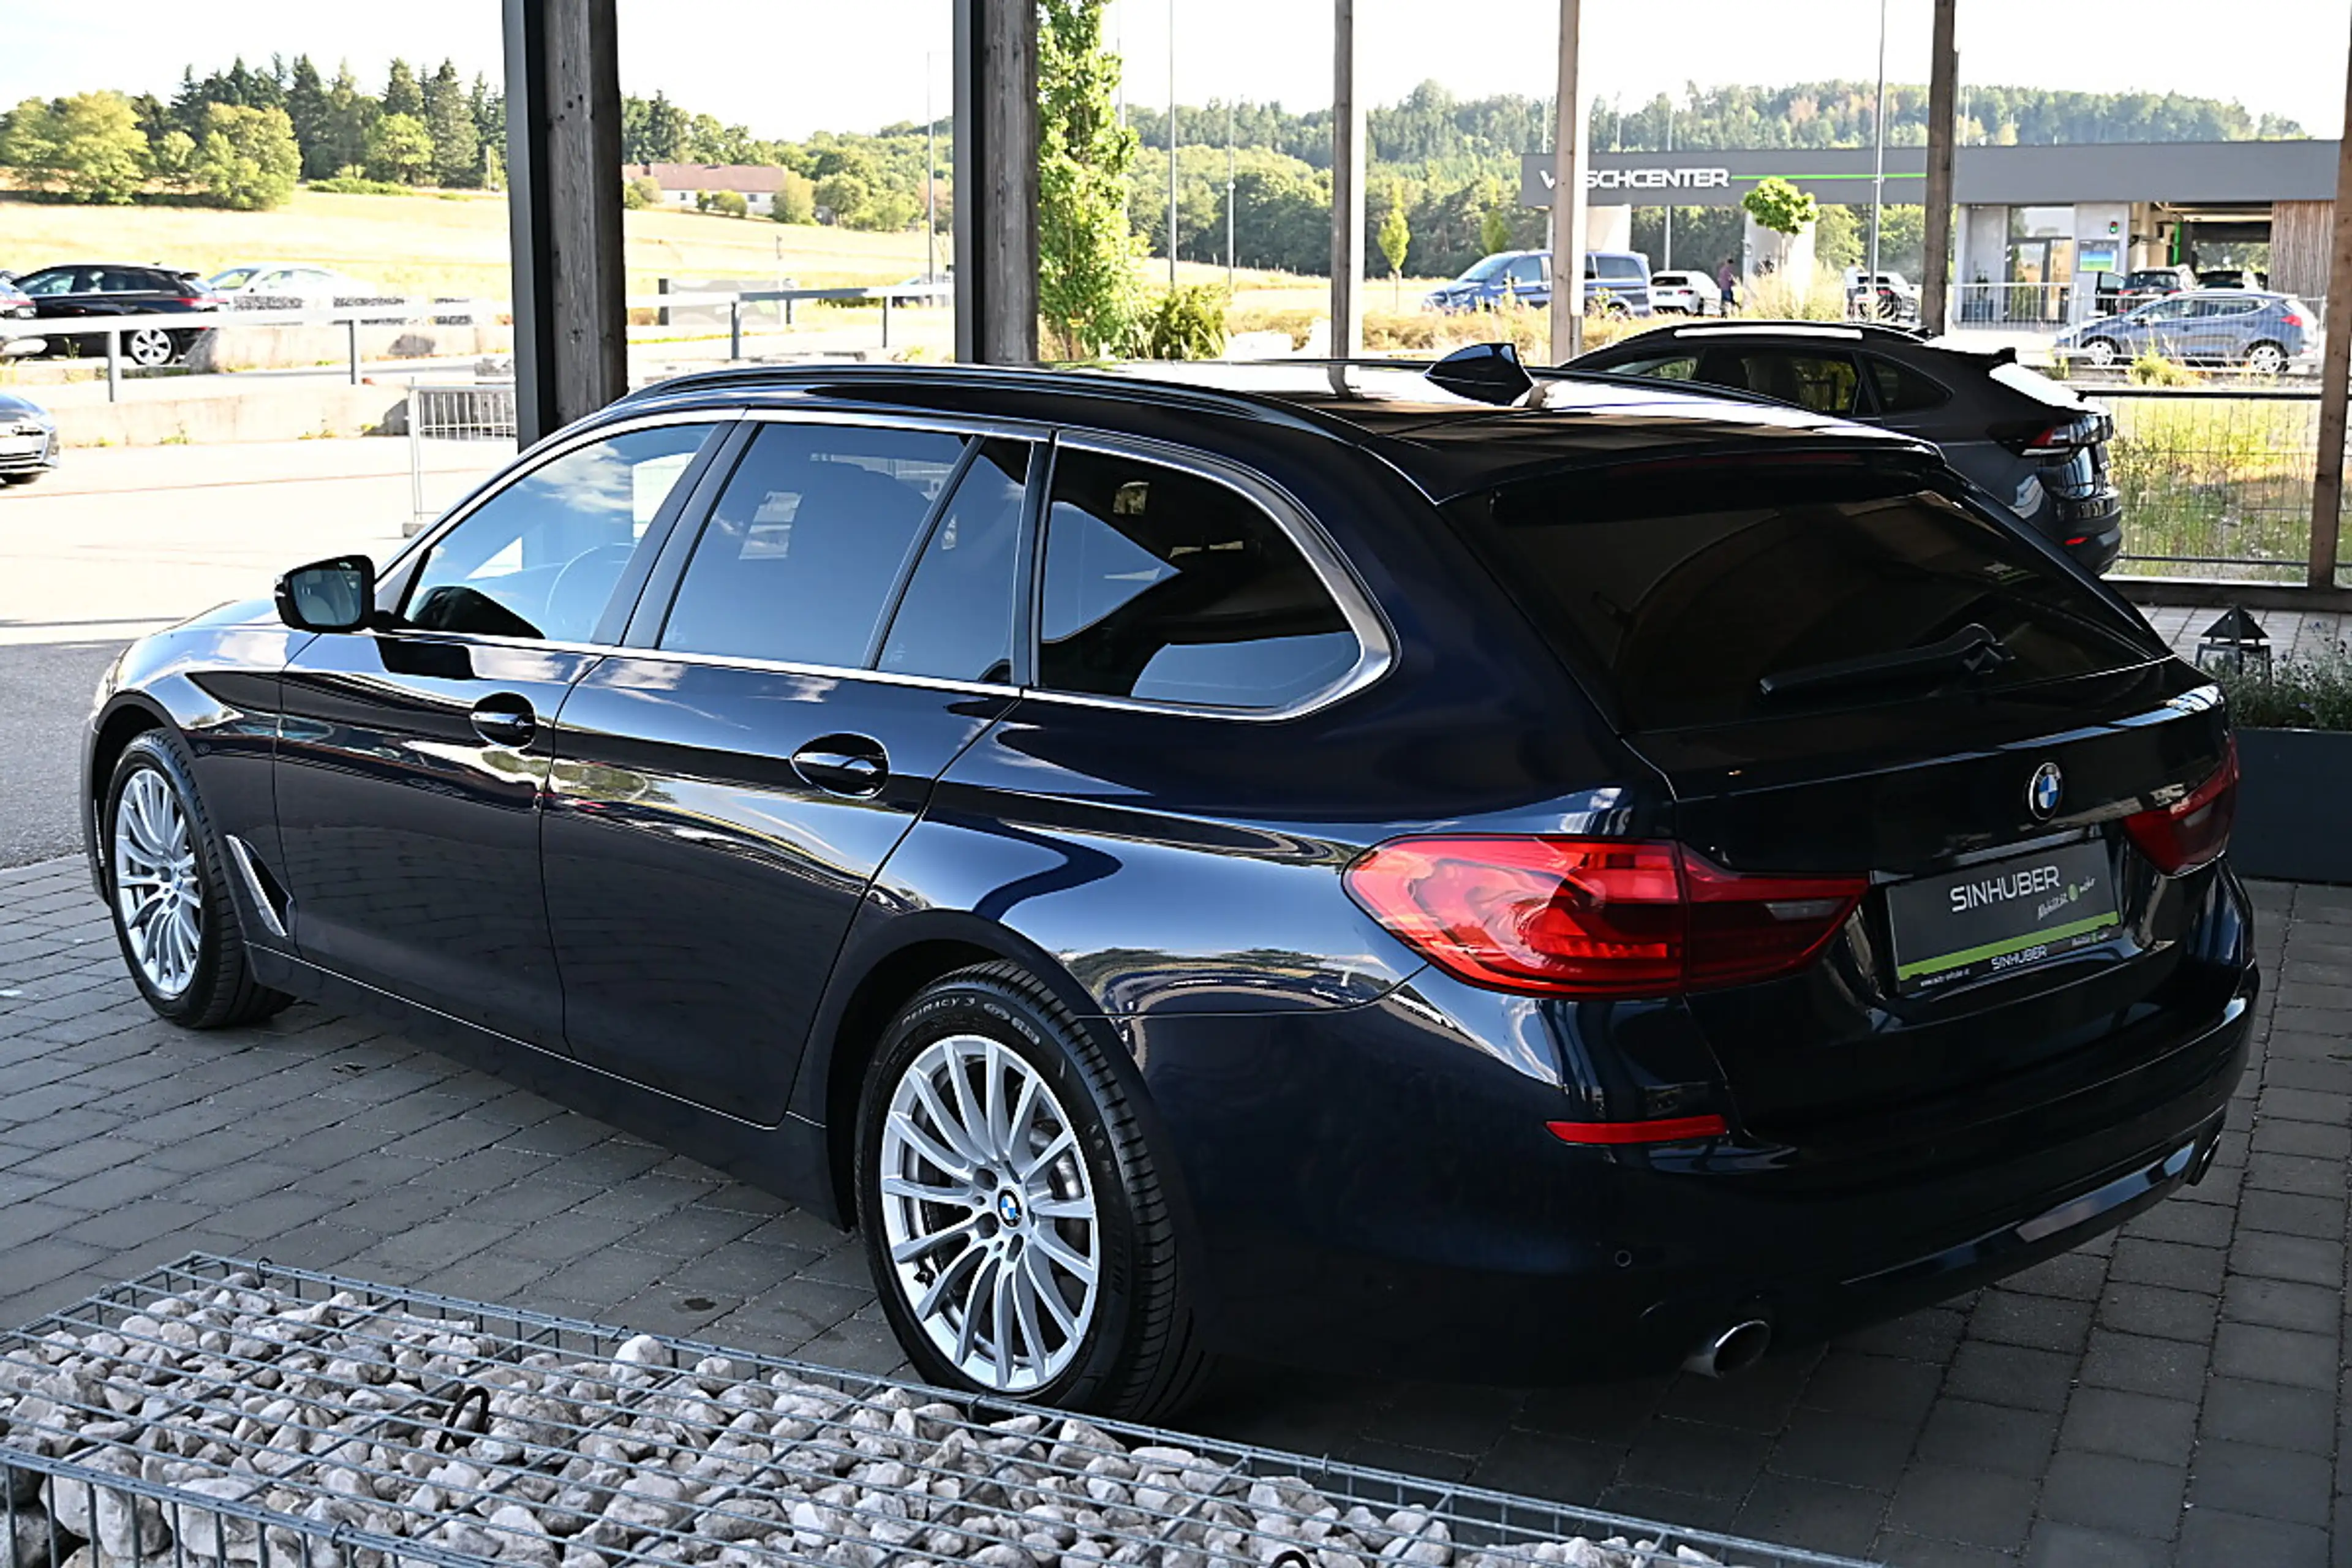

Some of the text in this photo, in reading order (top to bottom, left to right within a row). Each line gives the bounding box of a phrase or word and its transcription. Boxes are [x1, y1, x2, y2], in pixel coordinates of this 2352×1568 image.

[1540, 168, 1730, 189] WSCHCENTER
[1950, 865, 2060, 912] SINHUBER
[1991, 945, 2047, 970] SINHUBER
